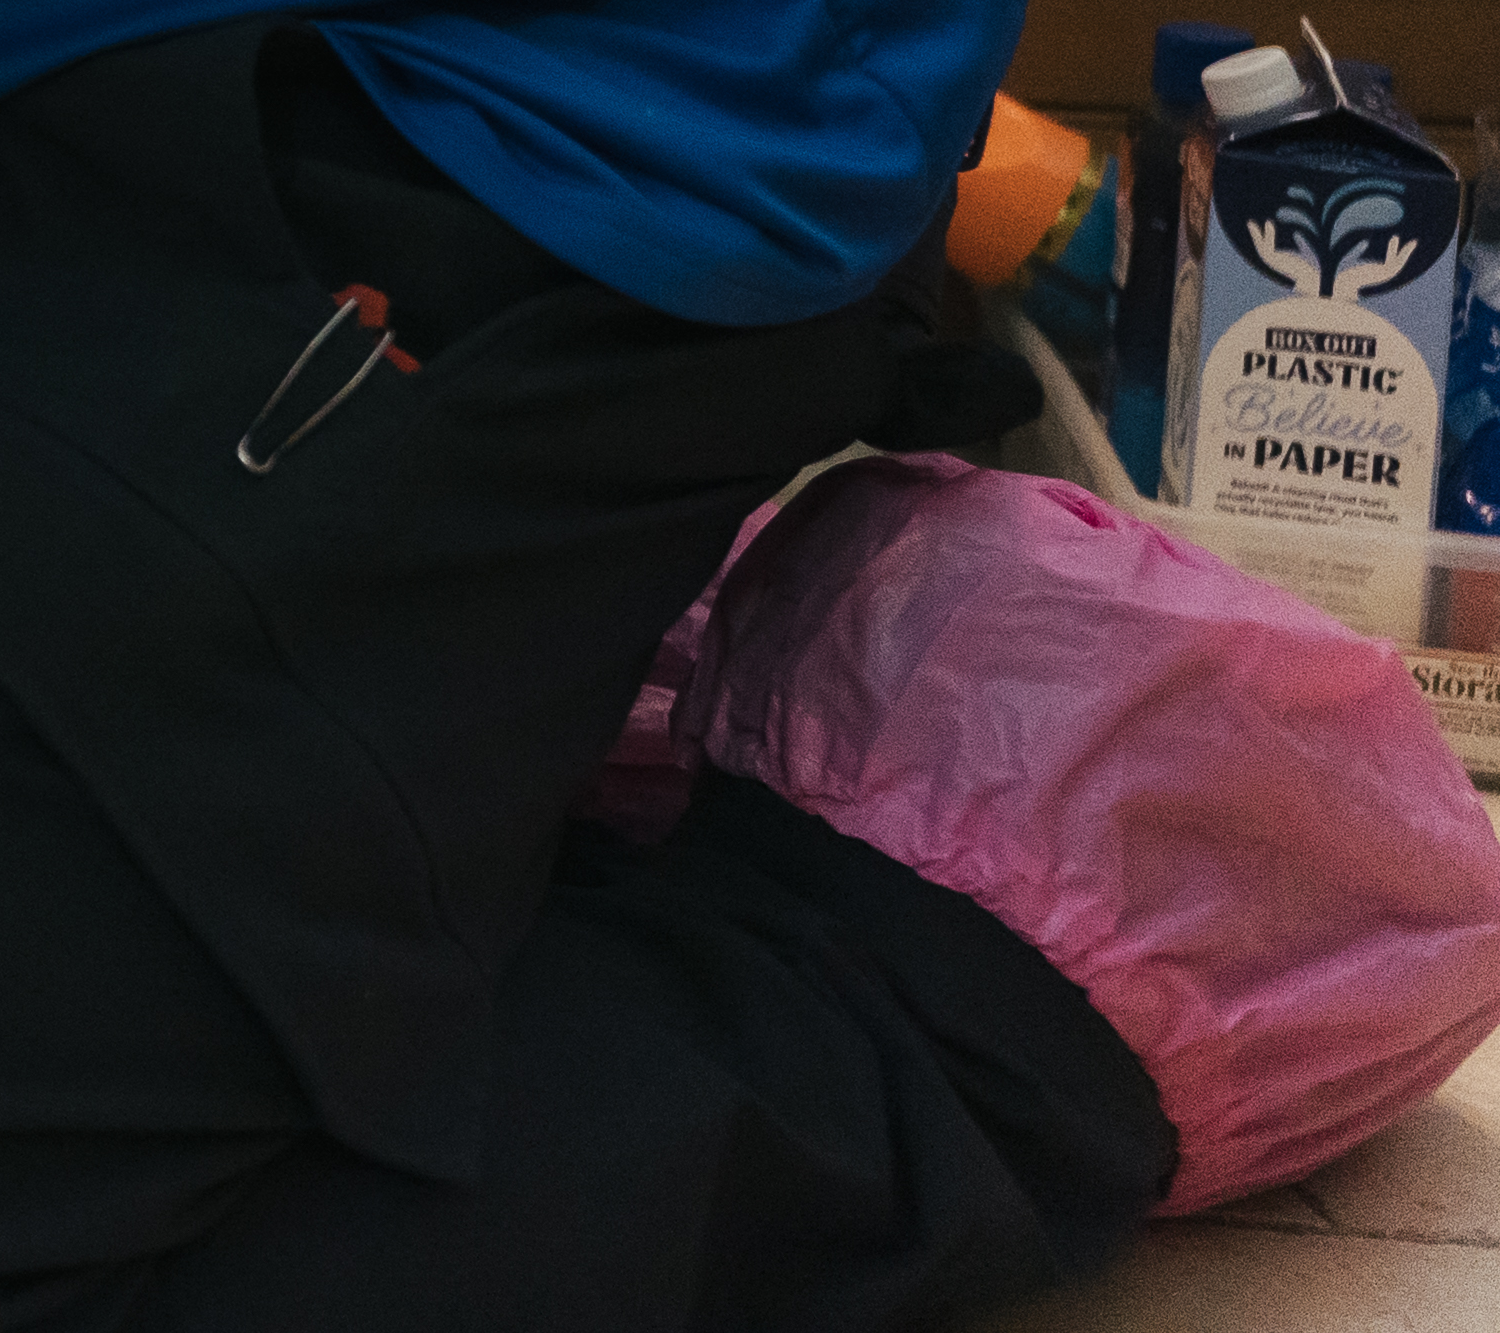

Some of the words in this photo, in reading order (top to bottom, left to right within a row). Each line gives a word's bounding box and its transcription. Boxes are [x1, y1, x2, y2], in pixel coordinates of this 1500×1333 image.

[1272, 330, 1318, 352] BOX
[1322, 335, 1370, 357] OUT
[1243, 351, 1399, 396] PLASTIC
[1224, 383, 1413, 447] Believe
[1224, 442, 1246, 460] IN
[1254, 436, 1401, 488] PAPER
